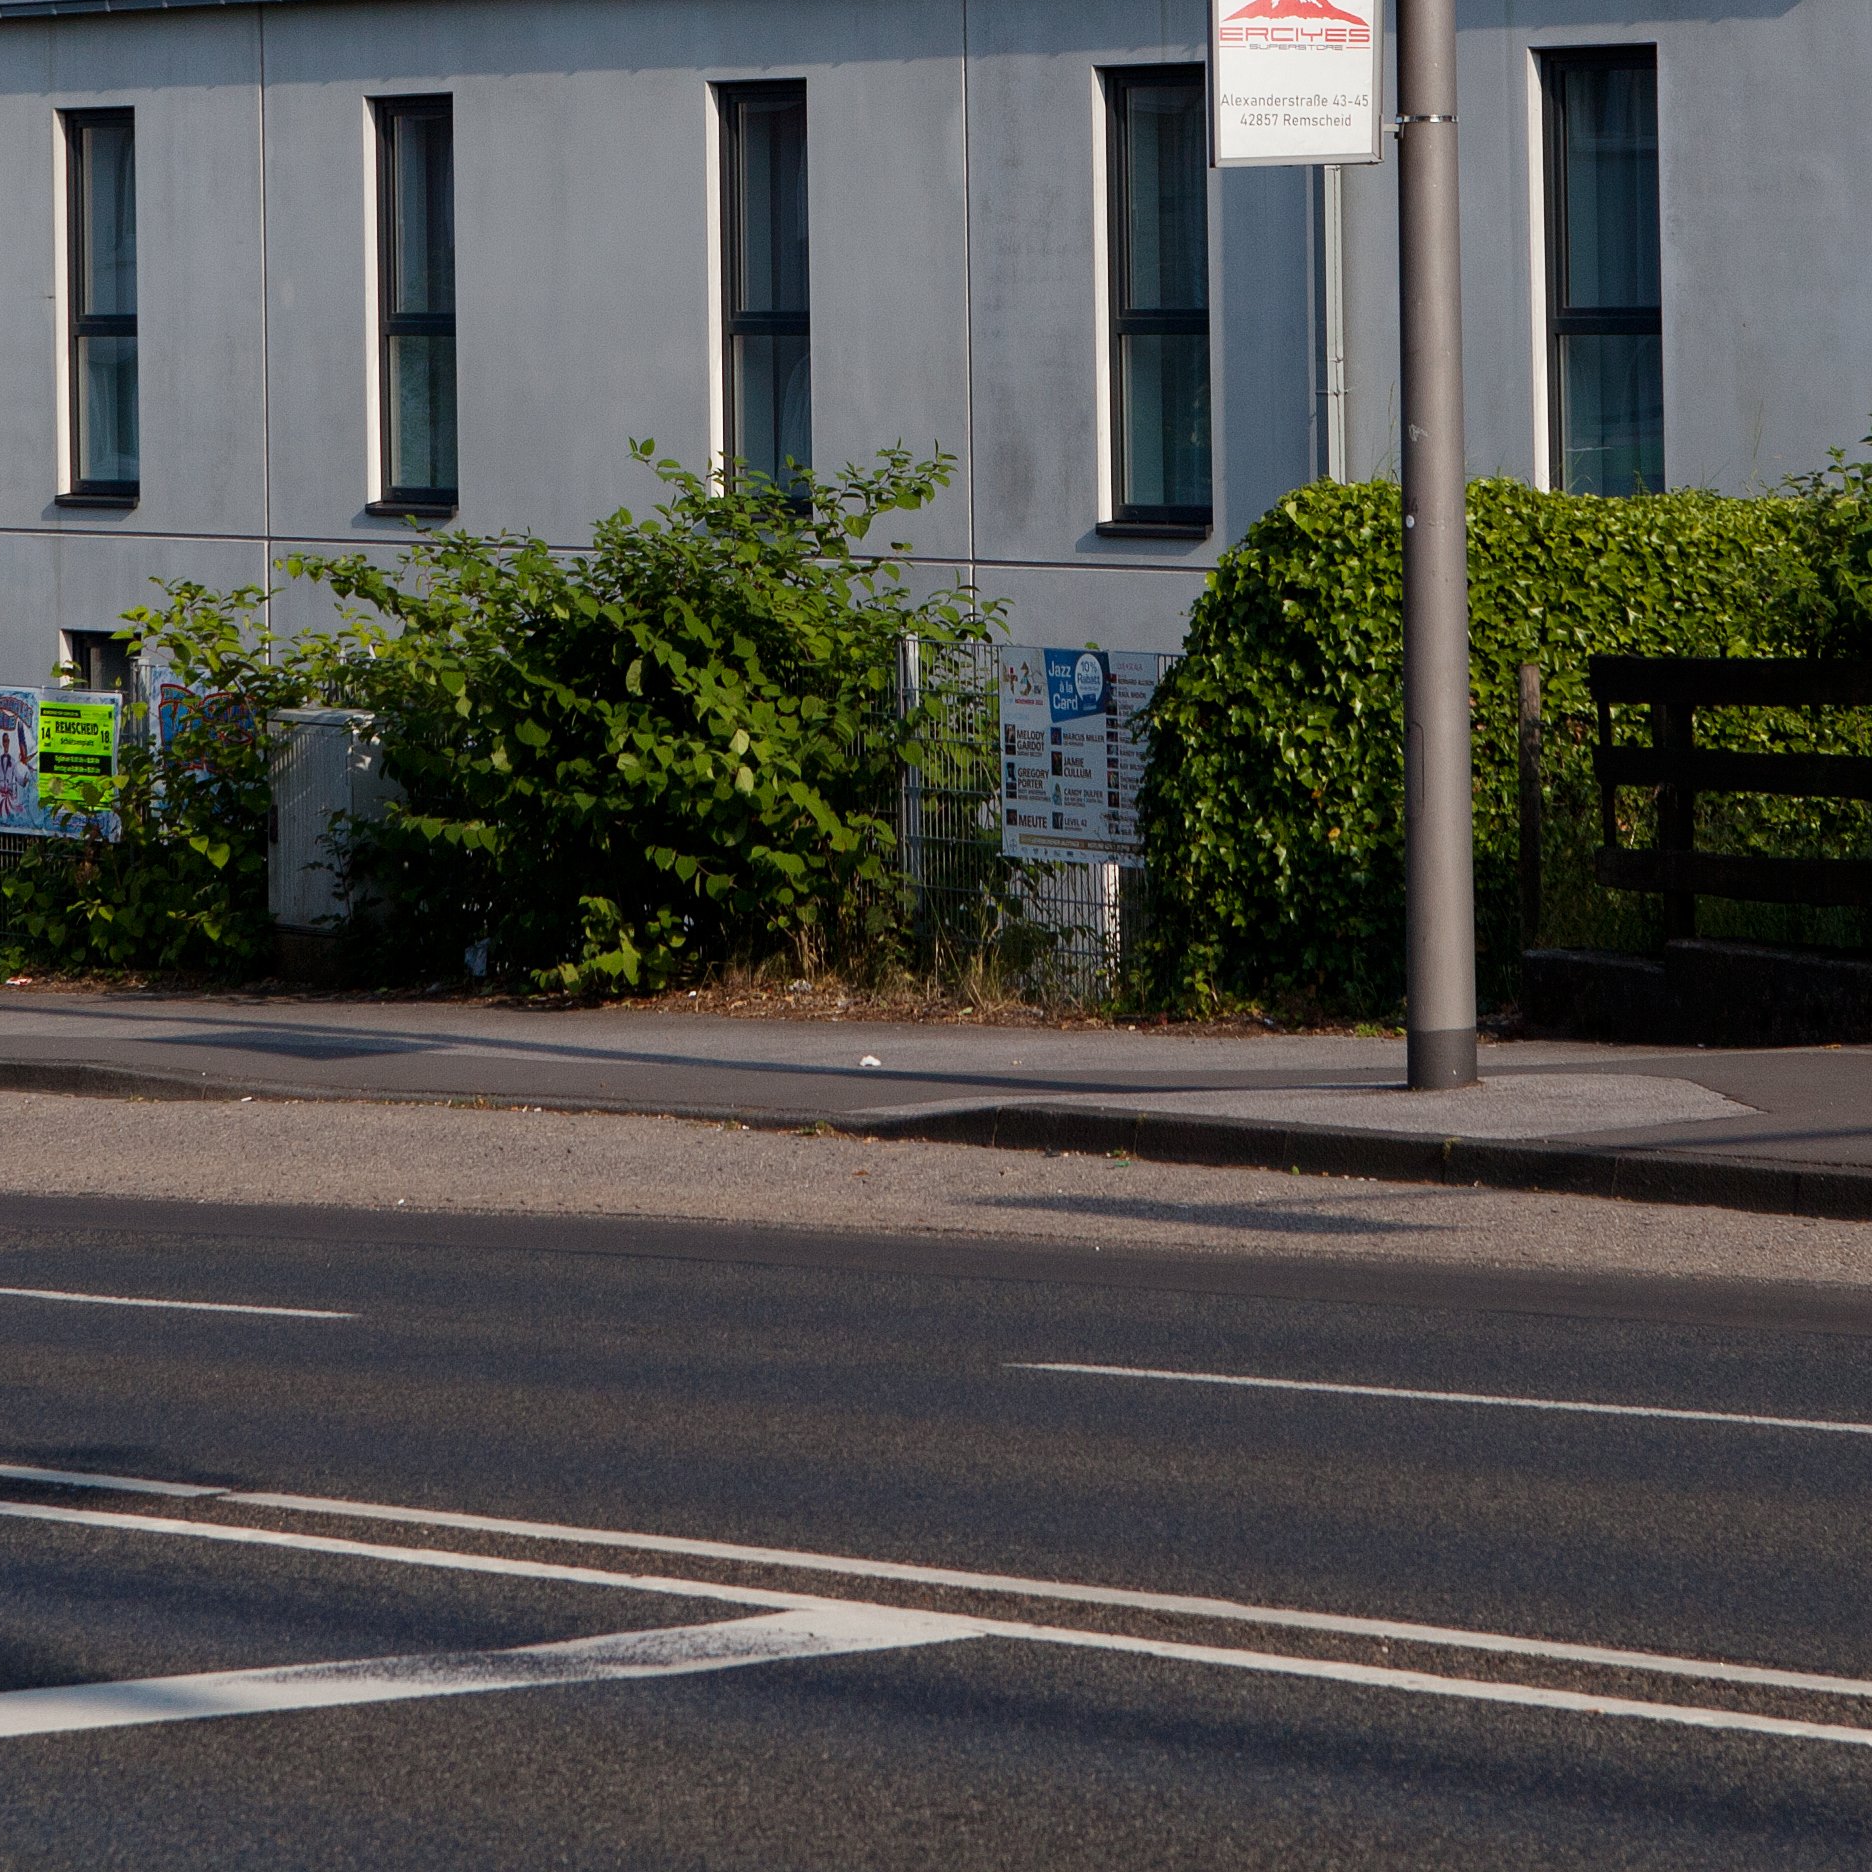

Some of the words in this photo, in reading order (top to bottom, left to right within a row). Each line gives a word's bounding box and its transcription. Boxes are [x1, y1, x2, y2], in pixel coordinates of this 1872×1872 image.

[1218, 26, 1371, 44] ERCIYES
[1249, 43, 1344, 51] SUPERSTORE
[1220, 93, 1328, 108] Alexanderstraße
[1332, 93, 1369, 107] 43-45
[1240, 114, 1279, 127] 42857
[1283, 113, 1352, 128] Remscheid
[1048, 660, 1072, 678] Jazz
[1077, 673, 1100, 685] Rabatt
[1065, 680, 1073, 694] la
[1052, 693, 1079, 711] Card
[55, 721, 98, 736] REMSCHEID
[1016, 729, 1045, 741] MELODY
[1063, 733, 1085, 742] MARCUS
[1086, 734, 1105, 743] MILLER
[1016, 740, 1045, 751] GARDOT
[1064, 756, 1084, 768] JAMIE
[1017, 767, 1049, 779] GREGORY
[1064, 767, 1092, 779] CULLUM
[1017, 778, 1043, 790] PORTER
[1064, 788, 1082, 797] CANDY
[1018, 814, 1048, 829] MEUTE
